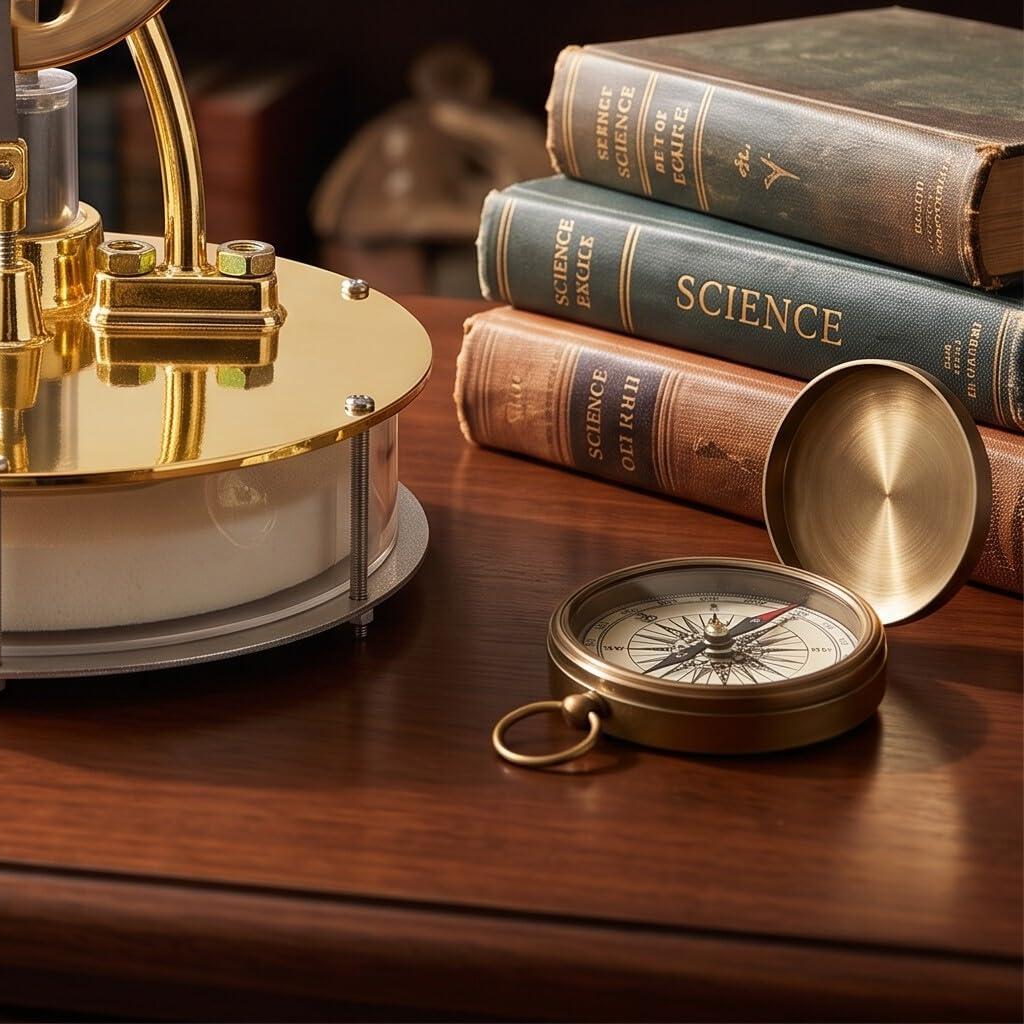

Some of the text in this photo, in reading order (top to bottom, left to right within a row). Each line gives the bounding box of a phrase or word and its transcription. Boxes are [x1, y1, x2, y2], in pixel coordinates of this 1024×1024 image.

[615, 84, 636, 180] SCIENCE
[554, 218, 576, 307] SCIENCE
[675, 274, 843, 347] SCIENCE
[587, 367, 608, 461] SCIENCE
